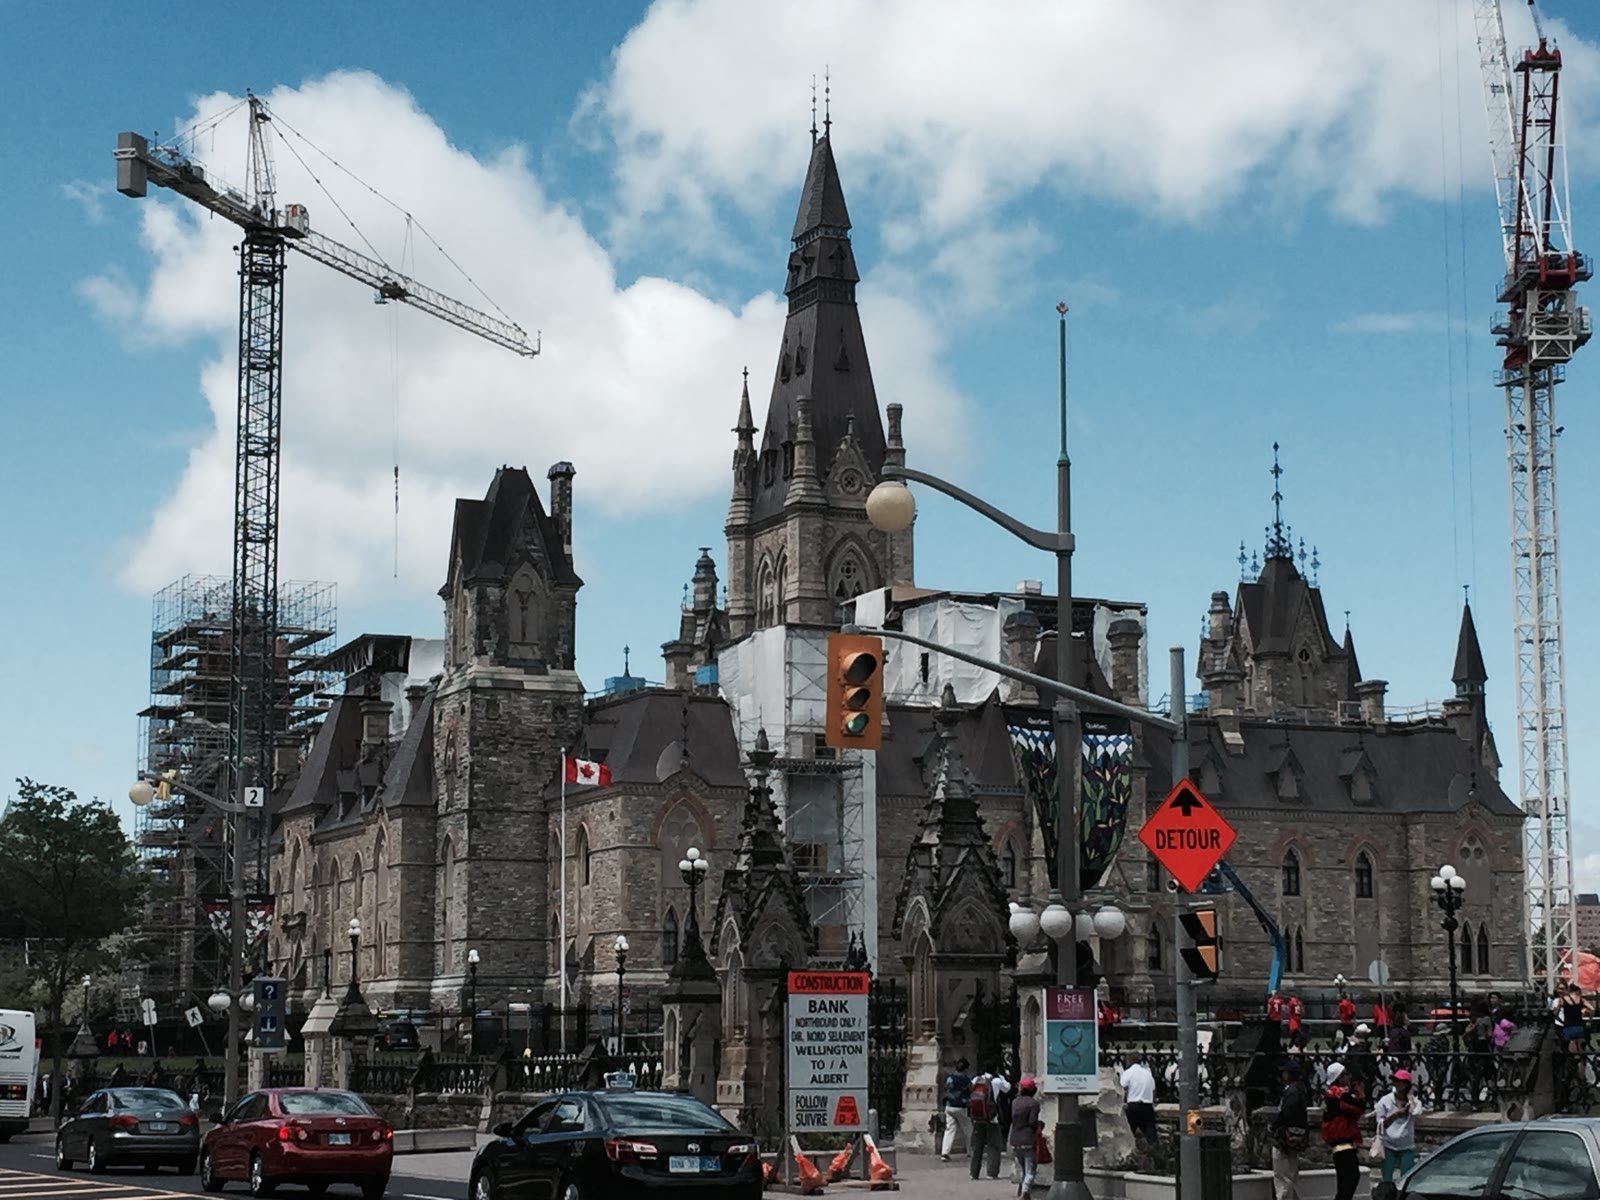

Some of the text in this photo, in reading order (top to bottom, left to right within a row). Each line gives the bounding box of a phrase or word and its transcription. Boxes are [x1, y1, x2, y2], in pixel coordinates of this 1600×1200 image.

[249, 789, 258, 804] 2
[1552, 796, 1560, 811] 1
[1155, 828, 1221, 850] DETOUR
[794, 976, 863, 990] CONSTRUCTION
[808, 999, 849, 1013] BANK
[1057, 994, 1085, 1005] FREE
[795, 1018, 837, 1028] NORTHBOUND
[840, 1018, 856, 1028] ONLY
[807, 1031, 826, 1042] NORD
[828, 1031, 866, 1042] SEULEMENT
[795, 1045, 863, 1056] WELLINGTON
[811, 1060, 825, 1070] TO
[810, 1073, 849, 1084] ALBERT
[795, 1095, 828, 1108] FOLLOW
[796, 1113, 828, 1127] SUIVRE
